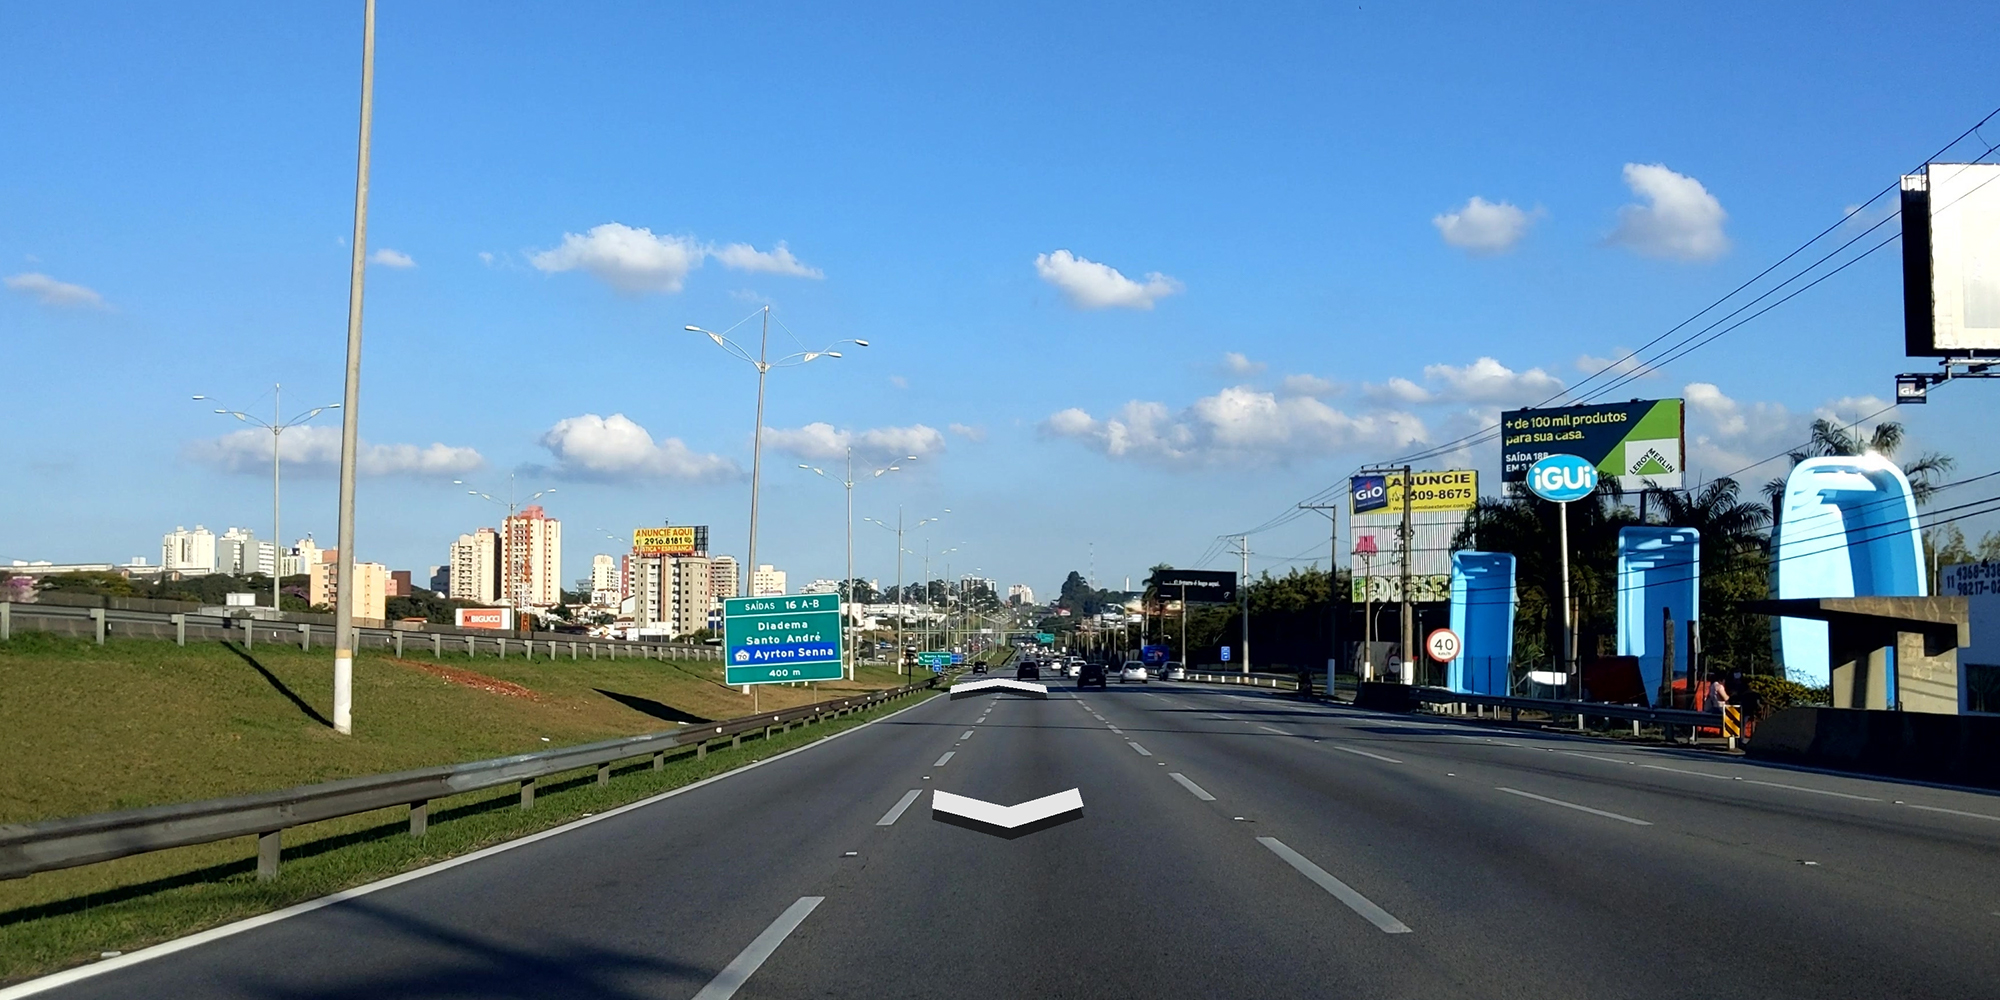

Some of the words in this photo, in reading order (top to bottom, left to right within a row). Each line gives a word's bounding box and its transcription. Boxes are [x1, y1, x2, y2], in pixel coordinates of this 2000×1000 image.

[1514, 418, 1529, 430] de
[1531, 416, 1551, 428] 100
[1552, 414, 1571, 427] mil
[1572, 411, 1627, 427] produtos
[1505, 434, 1532, 446] para
[1533, 432, 1554, 442] sua
[1555, 430, 1585, 441] casa.
[1505, 451, 1532, 463] SAÍDA
[1629, 452, 1651, 475] LEROY
[1648, 447, 1676, 473] MERLIN
[1506, 464, 1519, 472] EM
[1521, 463, 1527, 471] 3
[1533, 465, 1592, 490] iGUi
[1402, 488, 1471, 501] 509-8675
[635, 529, 672, 537] ANUNCIE
[673, 528, 693, 536] AQUI
[1946, 575, 1955, 589] 11
[745, 601, 775, 611] SAÍDAS
[785, 601, 797, 609] 16
[801, 599, 819, 609] A-B
[758, 621, 808, 631] Diadema
[746, 636, 780, 645] Santo
[786, 631, 821, 643] André
[1434, 639, 1454, 650] 40
[754, 649, 794, 661] Ayrton
[798, 648, 834, 657] Senna
[769, 669, 789, 677] 400
